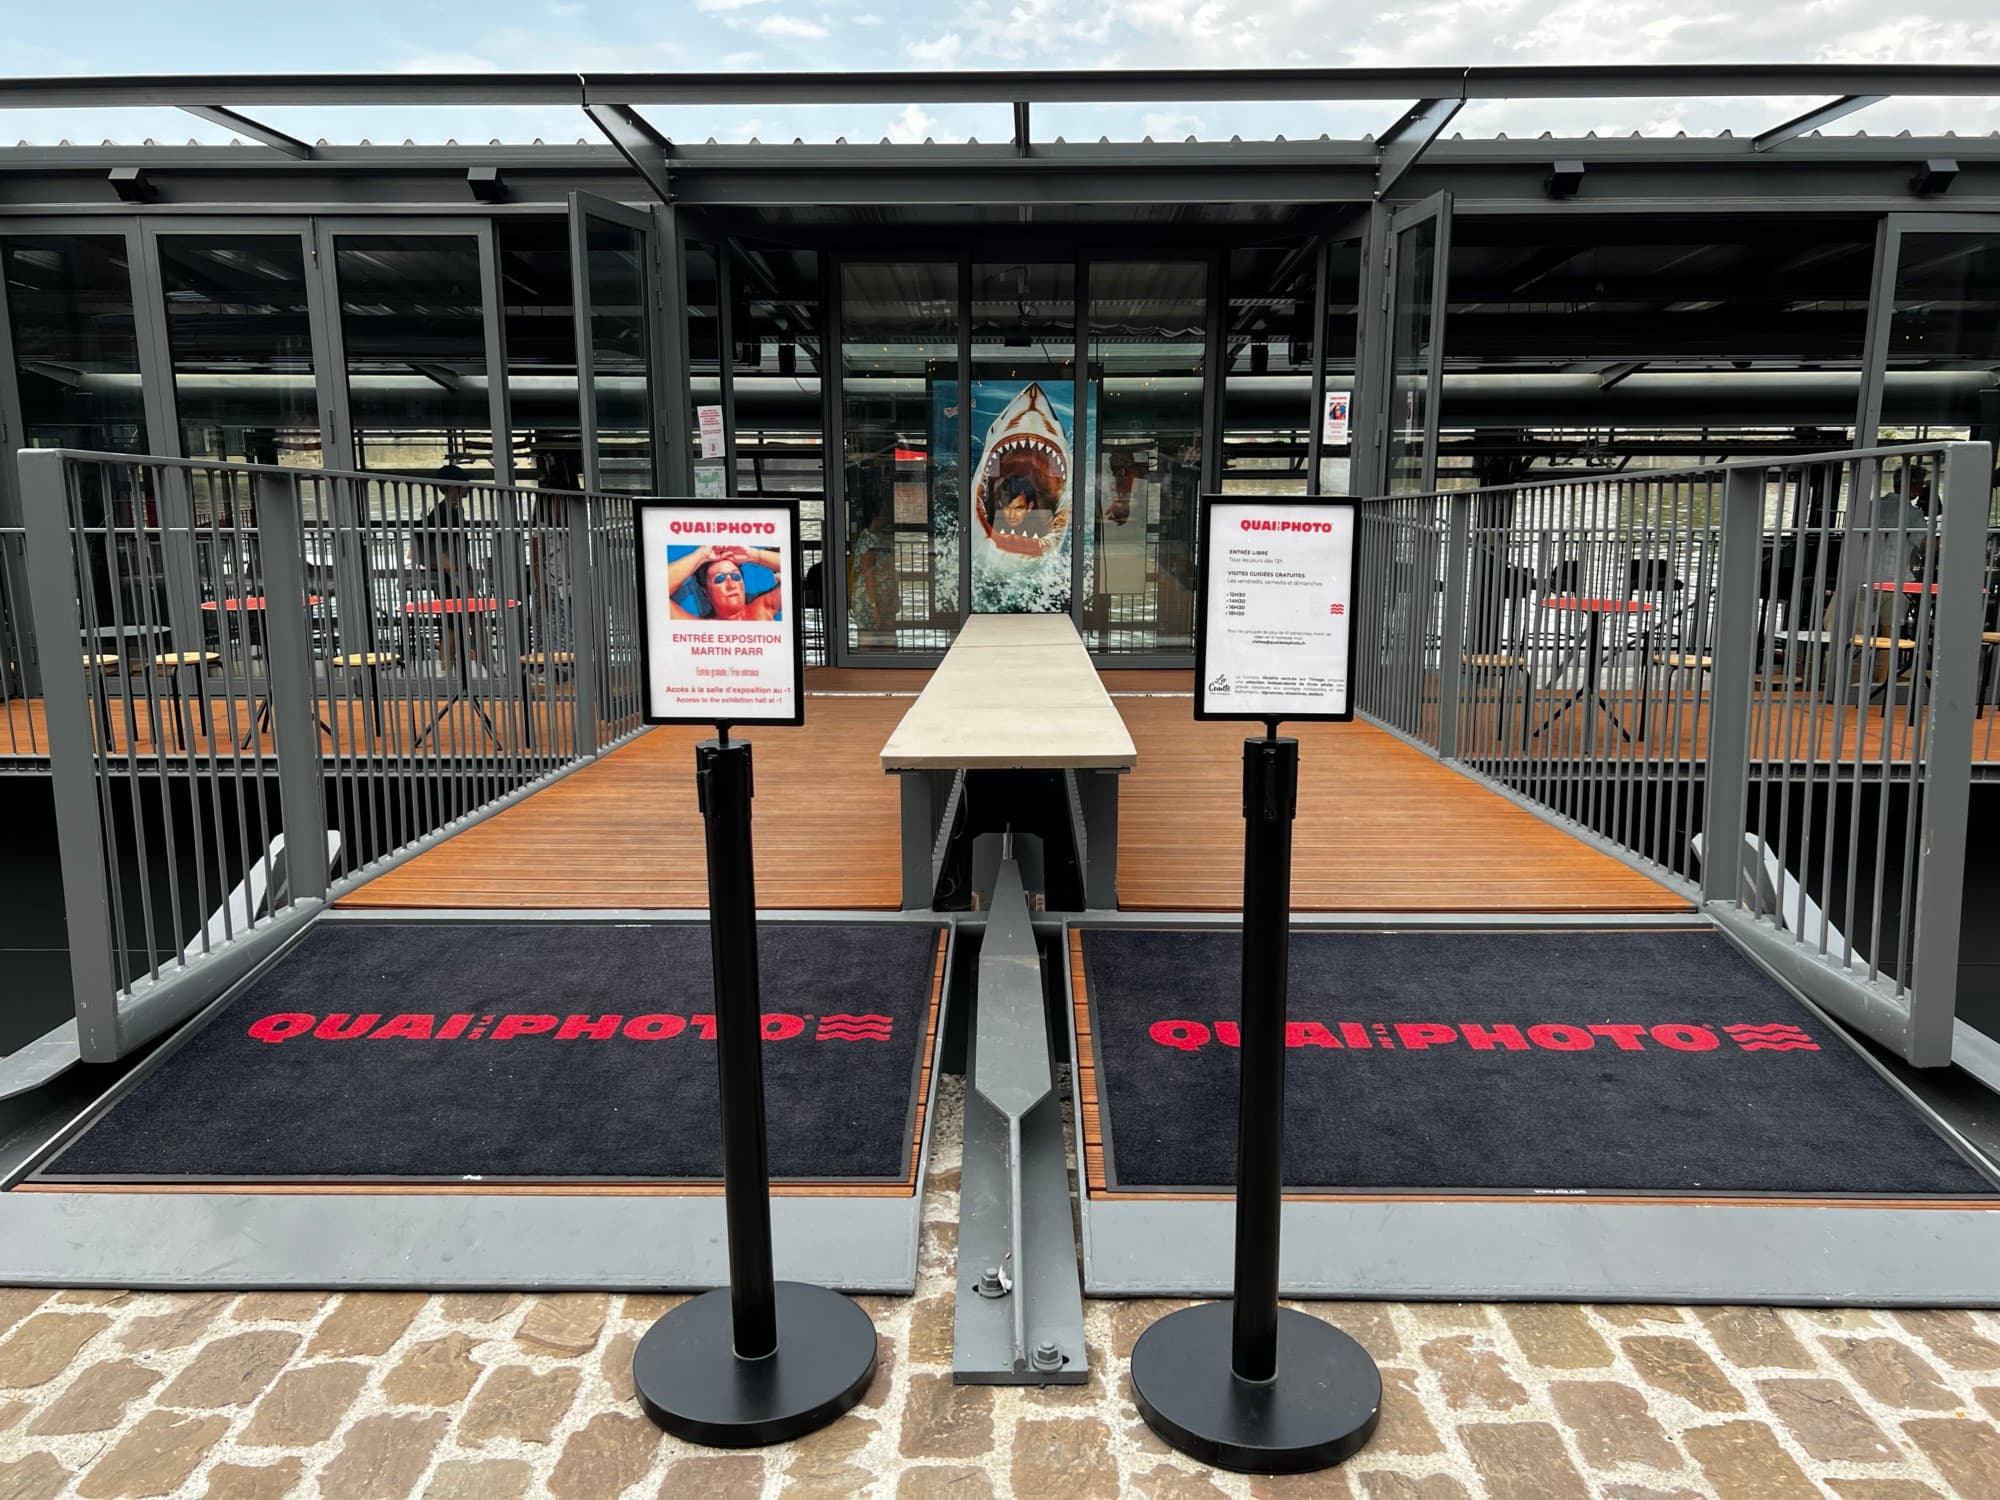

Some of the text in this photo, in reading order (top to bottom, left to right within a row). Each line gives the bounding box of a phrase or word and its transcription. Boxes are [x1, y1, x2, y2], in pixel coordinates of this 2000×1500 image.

[670, 521, 711, 534] QUAI
[717, 522, 775, 534] PHOTO
[1240, 520, 1276, 531] QUAI
[1281, 521, 1332, 533] PHOTO
[672, 632, 781, 644] ENTRÉE EXPOSITION
[691, 646, 763, 656] MARTIN PARR
[725, 687, 771, 695] d'exposition
[248, 1012, 474, 1043] QUAI
[1394, 1023, 1720, 1051] PHOTO
